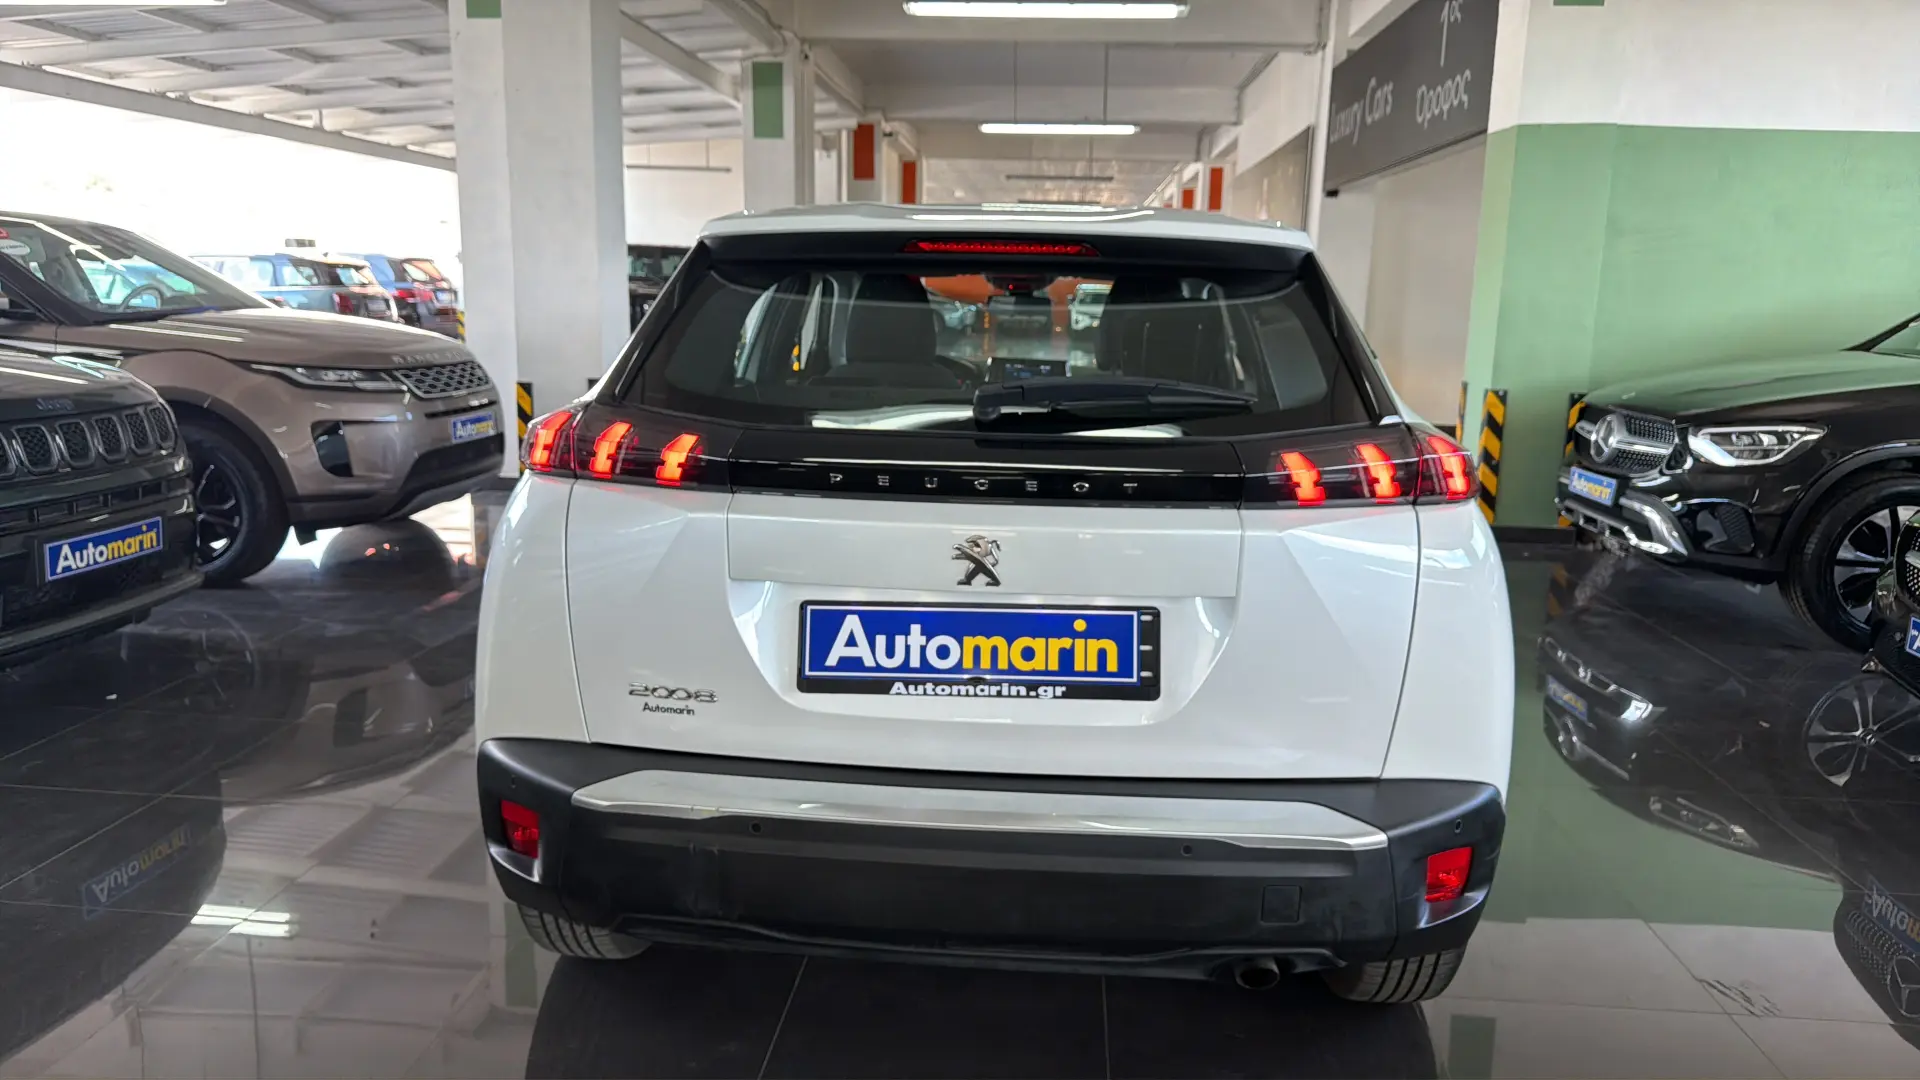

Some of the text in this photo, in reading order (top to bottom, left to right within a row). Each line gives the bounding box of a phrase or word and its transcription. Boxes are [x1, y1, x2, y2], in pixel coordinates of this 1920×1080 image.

[1330, 77, 1393, 146] Luxury Cars
[829, 473, 1138, 494] PEUGEOT
[55, 524, 158, 575] Automarin
[824, 614, 1118, 672] Automarin
[628, 682, 719, 703] 2008
[889, 681, 1067, 699] Automarin.gr
[642, 702, 695, 716] Automarin
